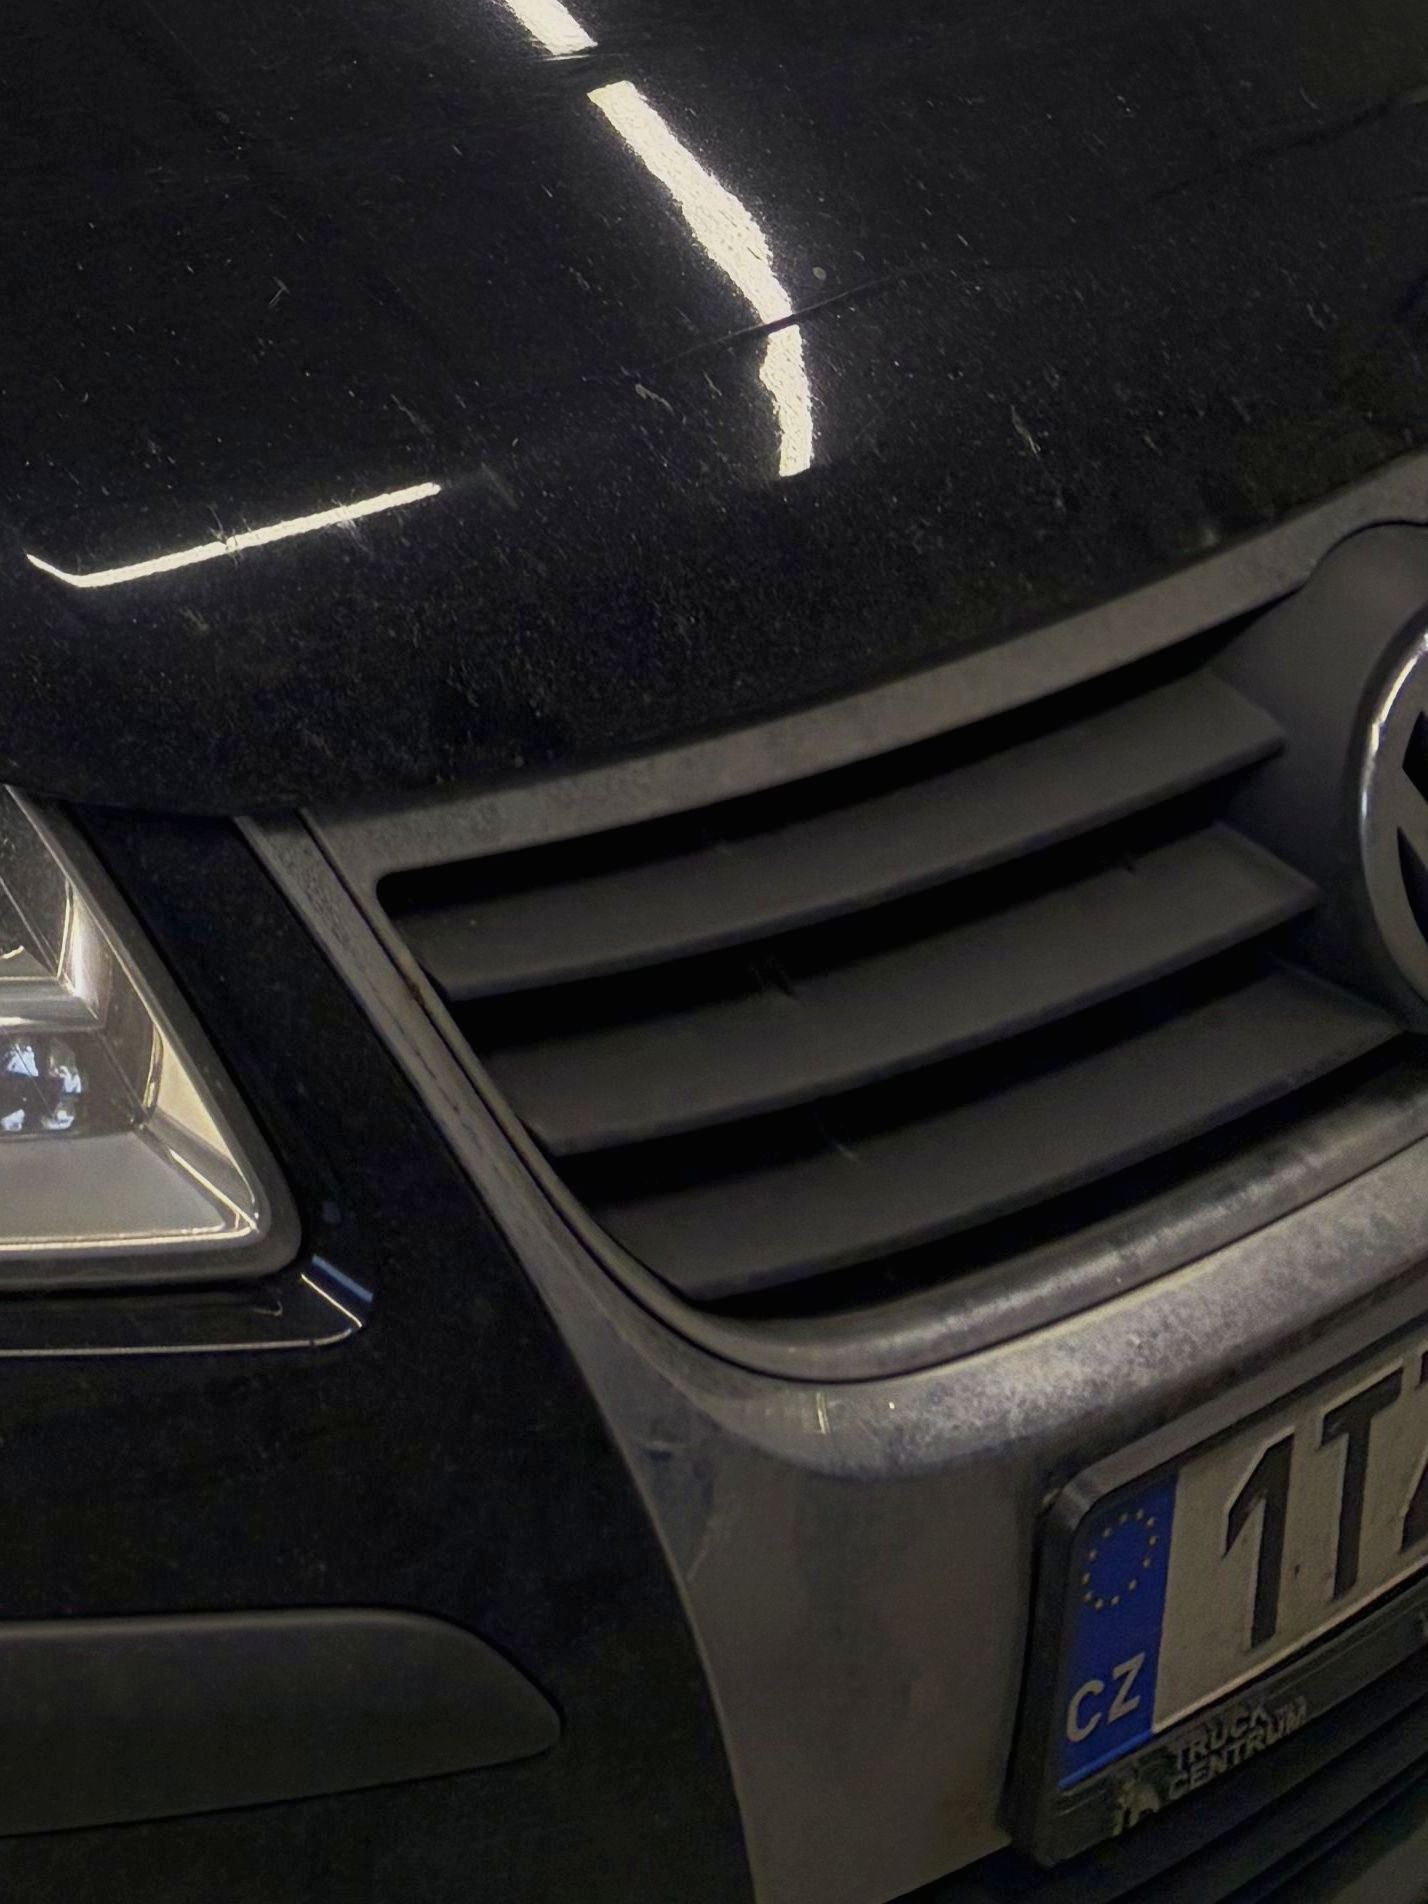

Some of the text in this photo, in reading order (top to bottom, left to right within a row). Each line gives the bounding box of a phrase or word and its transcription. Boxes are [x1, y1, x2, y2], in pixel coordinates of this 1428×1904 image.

[1223, 1347, 1428, 1651] 1T
[1065, 1651, 1146, 1744] CZ
[1172, 1705, 1273, 1769] TRUCK
[1167, 1699, 1307, 1802] CENTRUM
